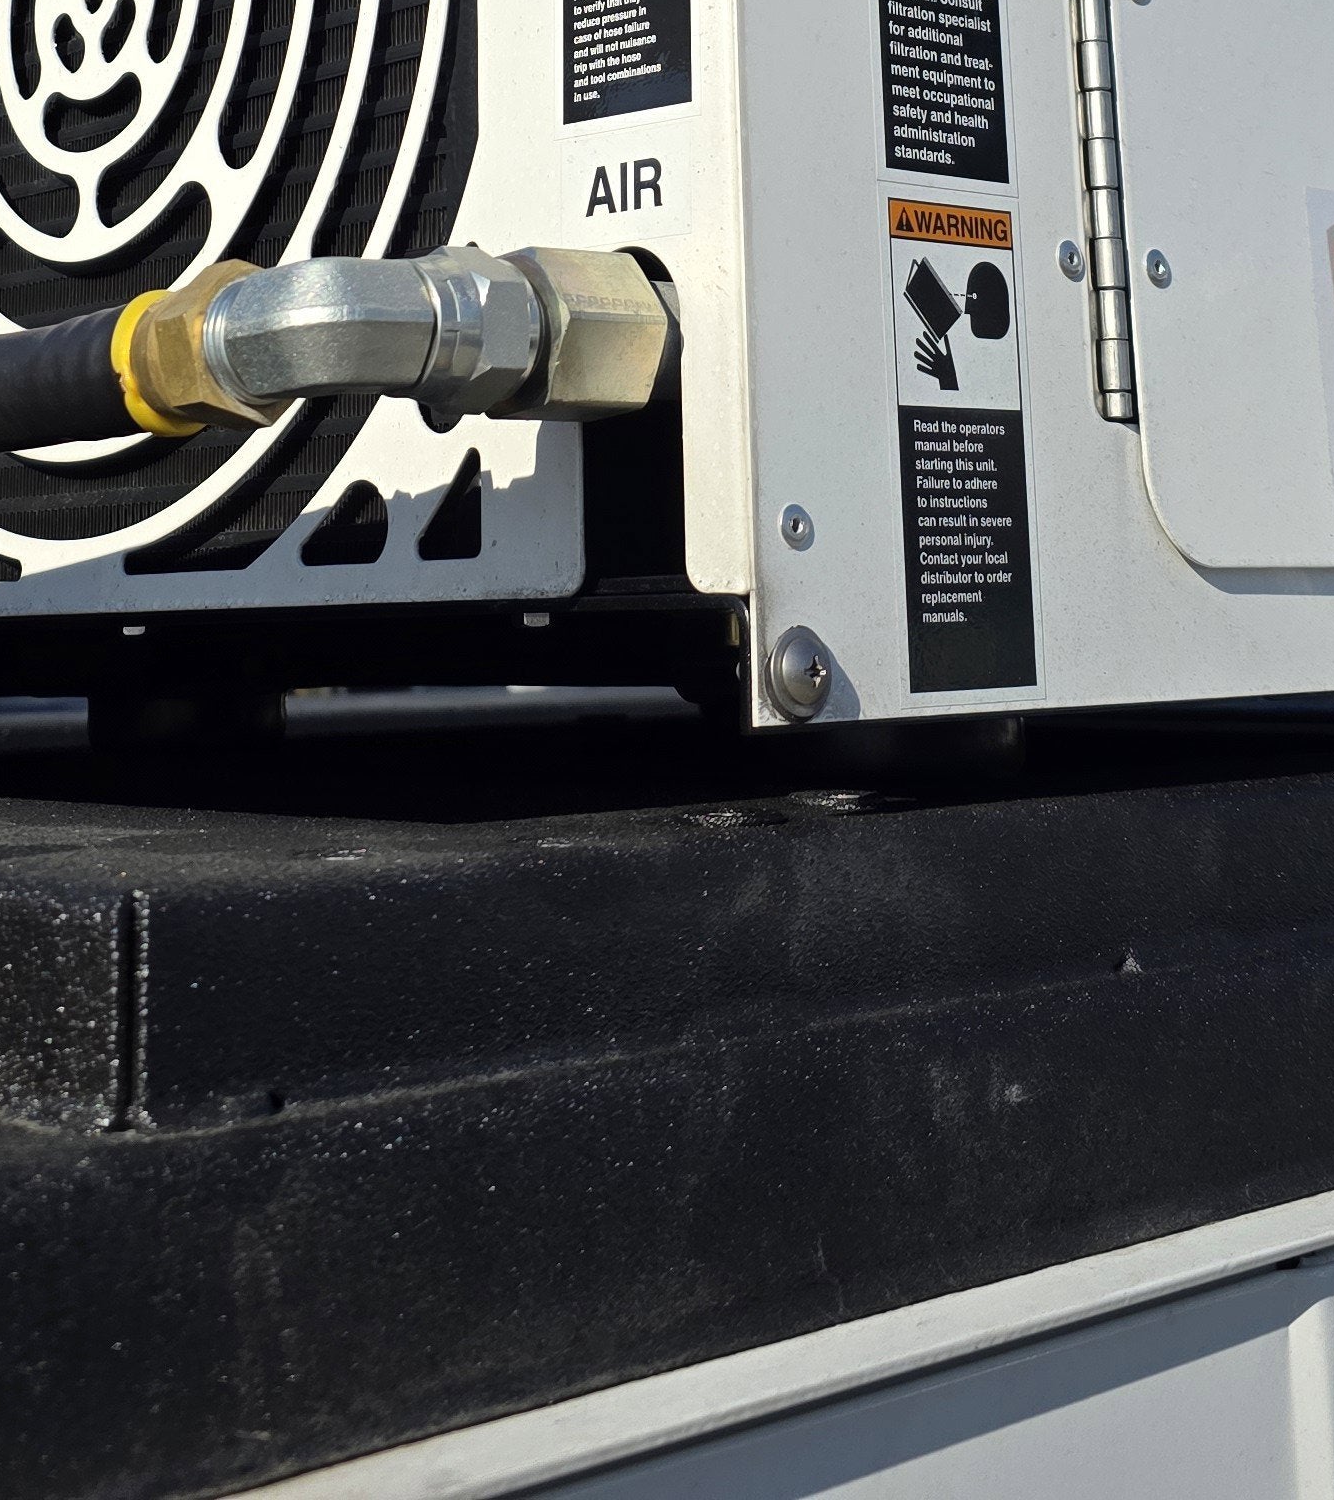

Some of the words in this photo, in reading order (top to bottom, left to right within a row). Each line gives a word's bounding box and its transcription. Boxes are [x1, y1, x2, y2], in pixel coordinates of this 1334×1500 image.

[887, 0, 935, 22] filtration
[938, 12, 991, 32] specialist
[888, 20, 905, 36] for
[907, 25, 963, 46] additional
[889, 40, 937, 62] filtration
[940, 52, 961, 65] and
[963, 53, 993, 70] treat-
[890, 63, 920, 78] ment
[922, 69, 981, 89] equipment
[983, 76, 995, 91] to
[891, 84, 920, 99] meet
[922, 89, 994, 110] occupational
[892, 103, 927, 123] safety
[930, 109, 951, 123] and
[953, 110, 988, 129] health
[893, 123, 975, 147] administration
[894, 144, 954, 164] standards.
[585, 157, 663, 218] AIR
[913, 209, 1008, 242] WARNING
[913, 419, 939, 432] Read
[940, 420, 956, 433] the
[959, 422, 1005, 436] operators
[914, 439, 950, 451] manual
[952, 439, 983, 452] before
[915, 457, 953, 473] starting
[955, 457, 973, 470] this
[975, 458, 997, 471] unit.
[916, 475, 950, 489] Failure
[952, 477, 962, 489] to
[964, 476, 997, 489] adhere
[916, 495, 927, 507] to
[929, 494, 987, 508] instructions
[917, 516, 936, 526] can
[938, 514, 967, 527] result
[968, 513, 978, 526] in
[980, 516, 1012, 527] severe
[918, 533, 962, 548] personal
[963, 532, 993, 548] injury.
[919, 551, 958, 565] Contact
[960, 554, 982, 567] your
[984, 550, 1008, 564] local
[920, 570, 972, 584] distributor
[973, 571, 984, 583] to
[986, 569, 1012, 583] order
[921, 589, 982, 606] replacement
[922, 608, 967, 622] manuals.
